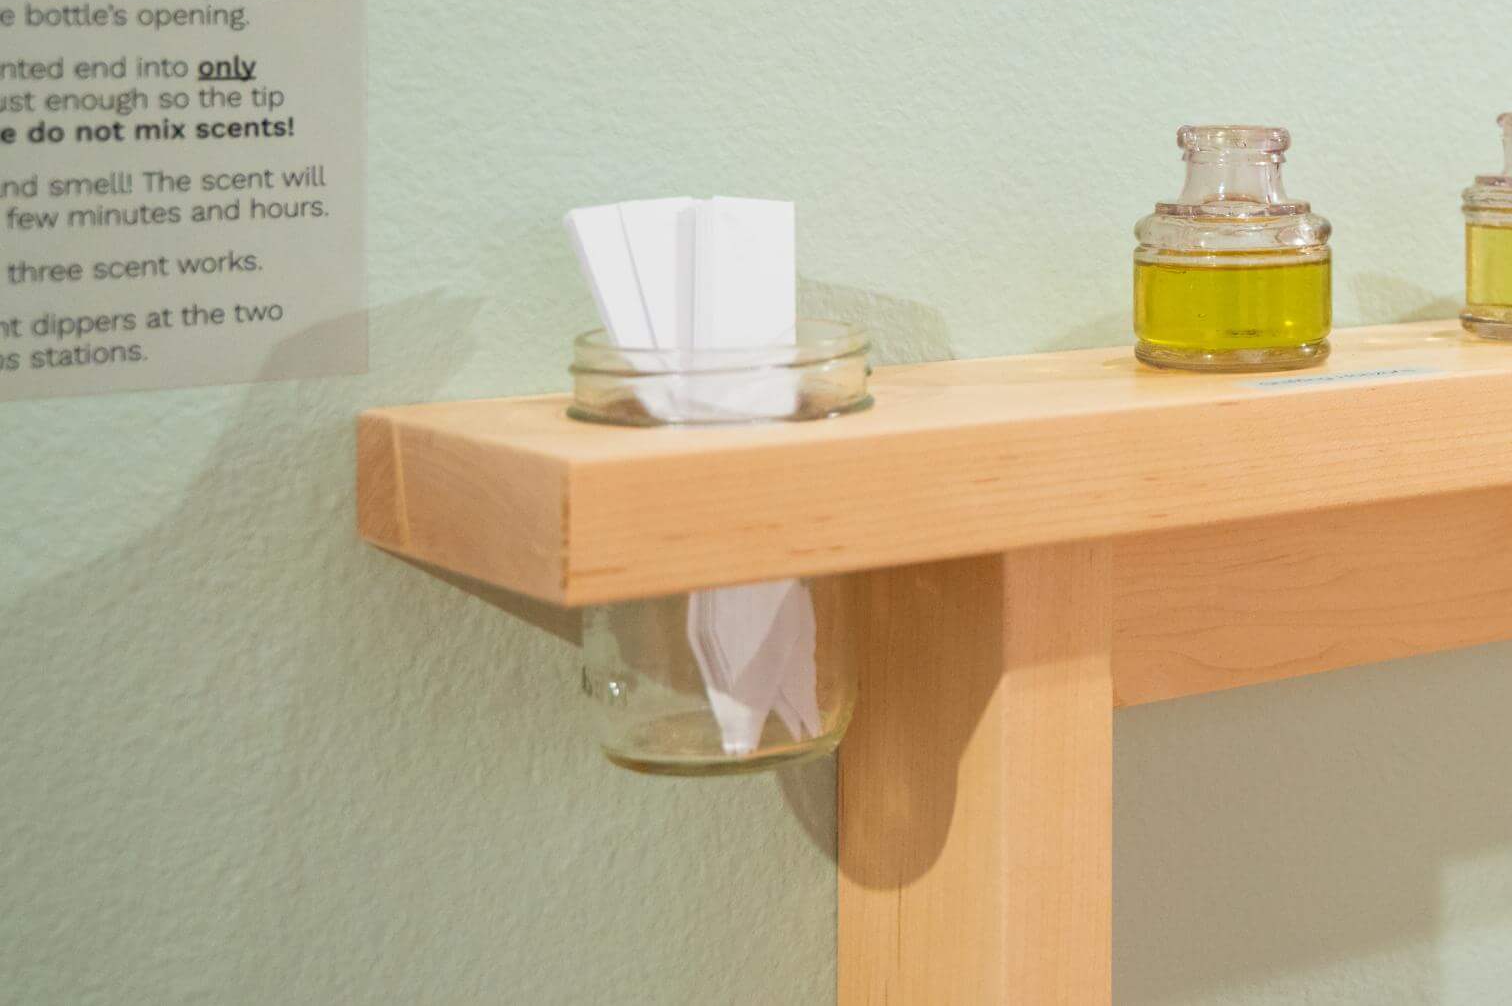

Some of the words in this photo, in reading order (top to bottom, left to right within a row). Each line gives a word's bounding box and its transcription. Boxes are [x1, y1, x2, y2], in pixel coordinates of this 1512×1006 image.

[23, 4, 129, 27] bottle's
[135, 4, 251, 30] opening.
[73, 57, 127, 79] end
[136, 59, 189, 78] into
[196, 55, 257, 83] only
[43, 89, 149, 115] enough
[157, 91, 191, 110] so
[197, 87, 243, 109] the
[250, 86, 286, 112] tip
[26, 121, 66, 144] do
[74, 121, 125, 142] not
[133, 118, 186, 140] mix
[194, 116, 295, 140] scents!
[47, 172, 133, 198] smell!
[141, 170, 192, 193] The
[200, 169, 275, 192] scent
[280, 165, 327, 188] will
[5, 207, 60, 231] few
[66, 204, 182, 227] minutes
[189, 198, 241, 223] and
[249, 198, 330, 219] hours.
[6, 261, 84, 285] three
[91, 256, 170, 280] scent
[176, 250, 263, 275] works.
[29, 313, 137, 339] dippers
[145, 308, 174, 329] at
[180, 304, 226, 327] the
[233, 303, 284, 324] two
[29, 342, 149, 370] stations.
